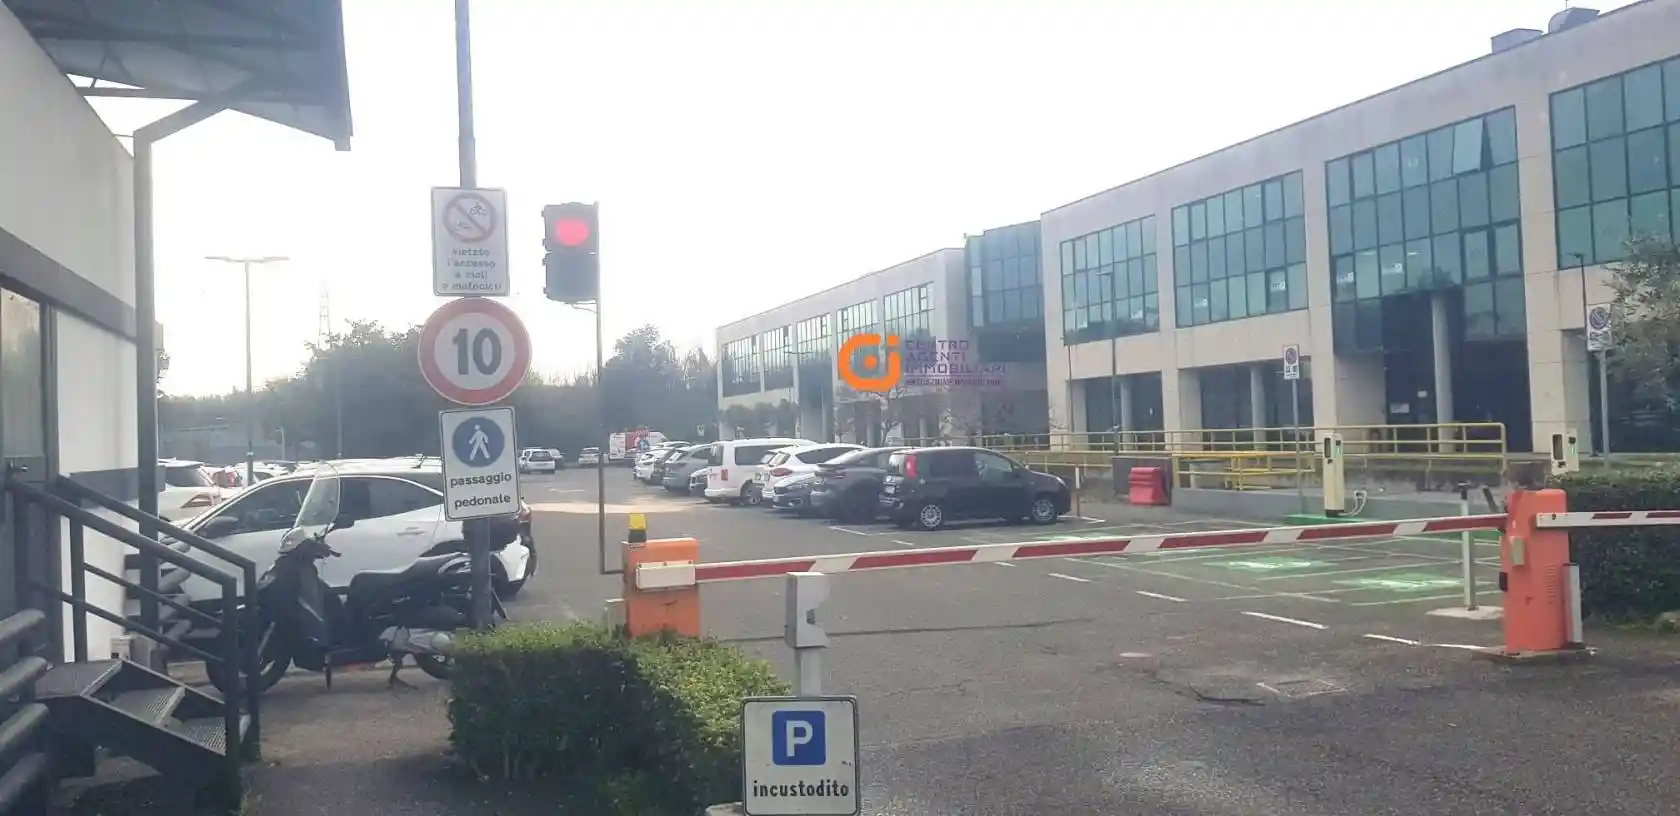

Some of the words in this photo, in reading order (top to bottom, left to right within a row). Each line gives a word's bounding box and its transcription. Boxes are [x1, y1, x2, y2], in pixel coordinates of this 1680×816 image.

[452, 328, 502, 376] 10
[450, 471, 512, 488] passaggio
[454, 493, 511, 509] pedonale
[786, 719, 814, 757] P
[753, 779, 849, 797] incustodito
